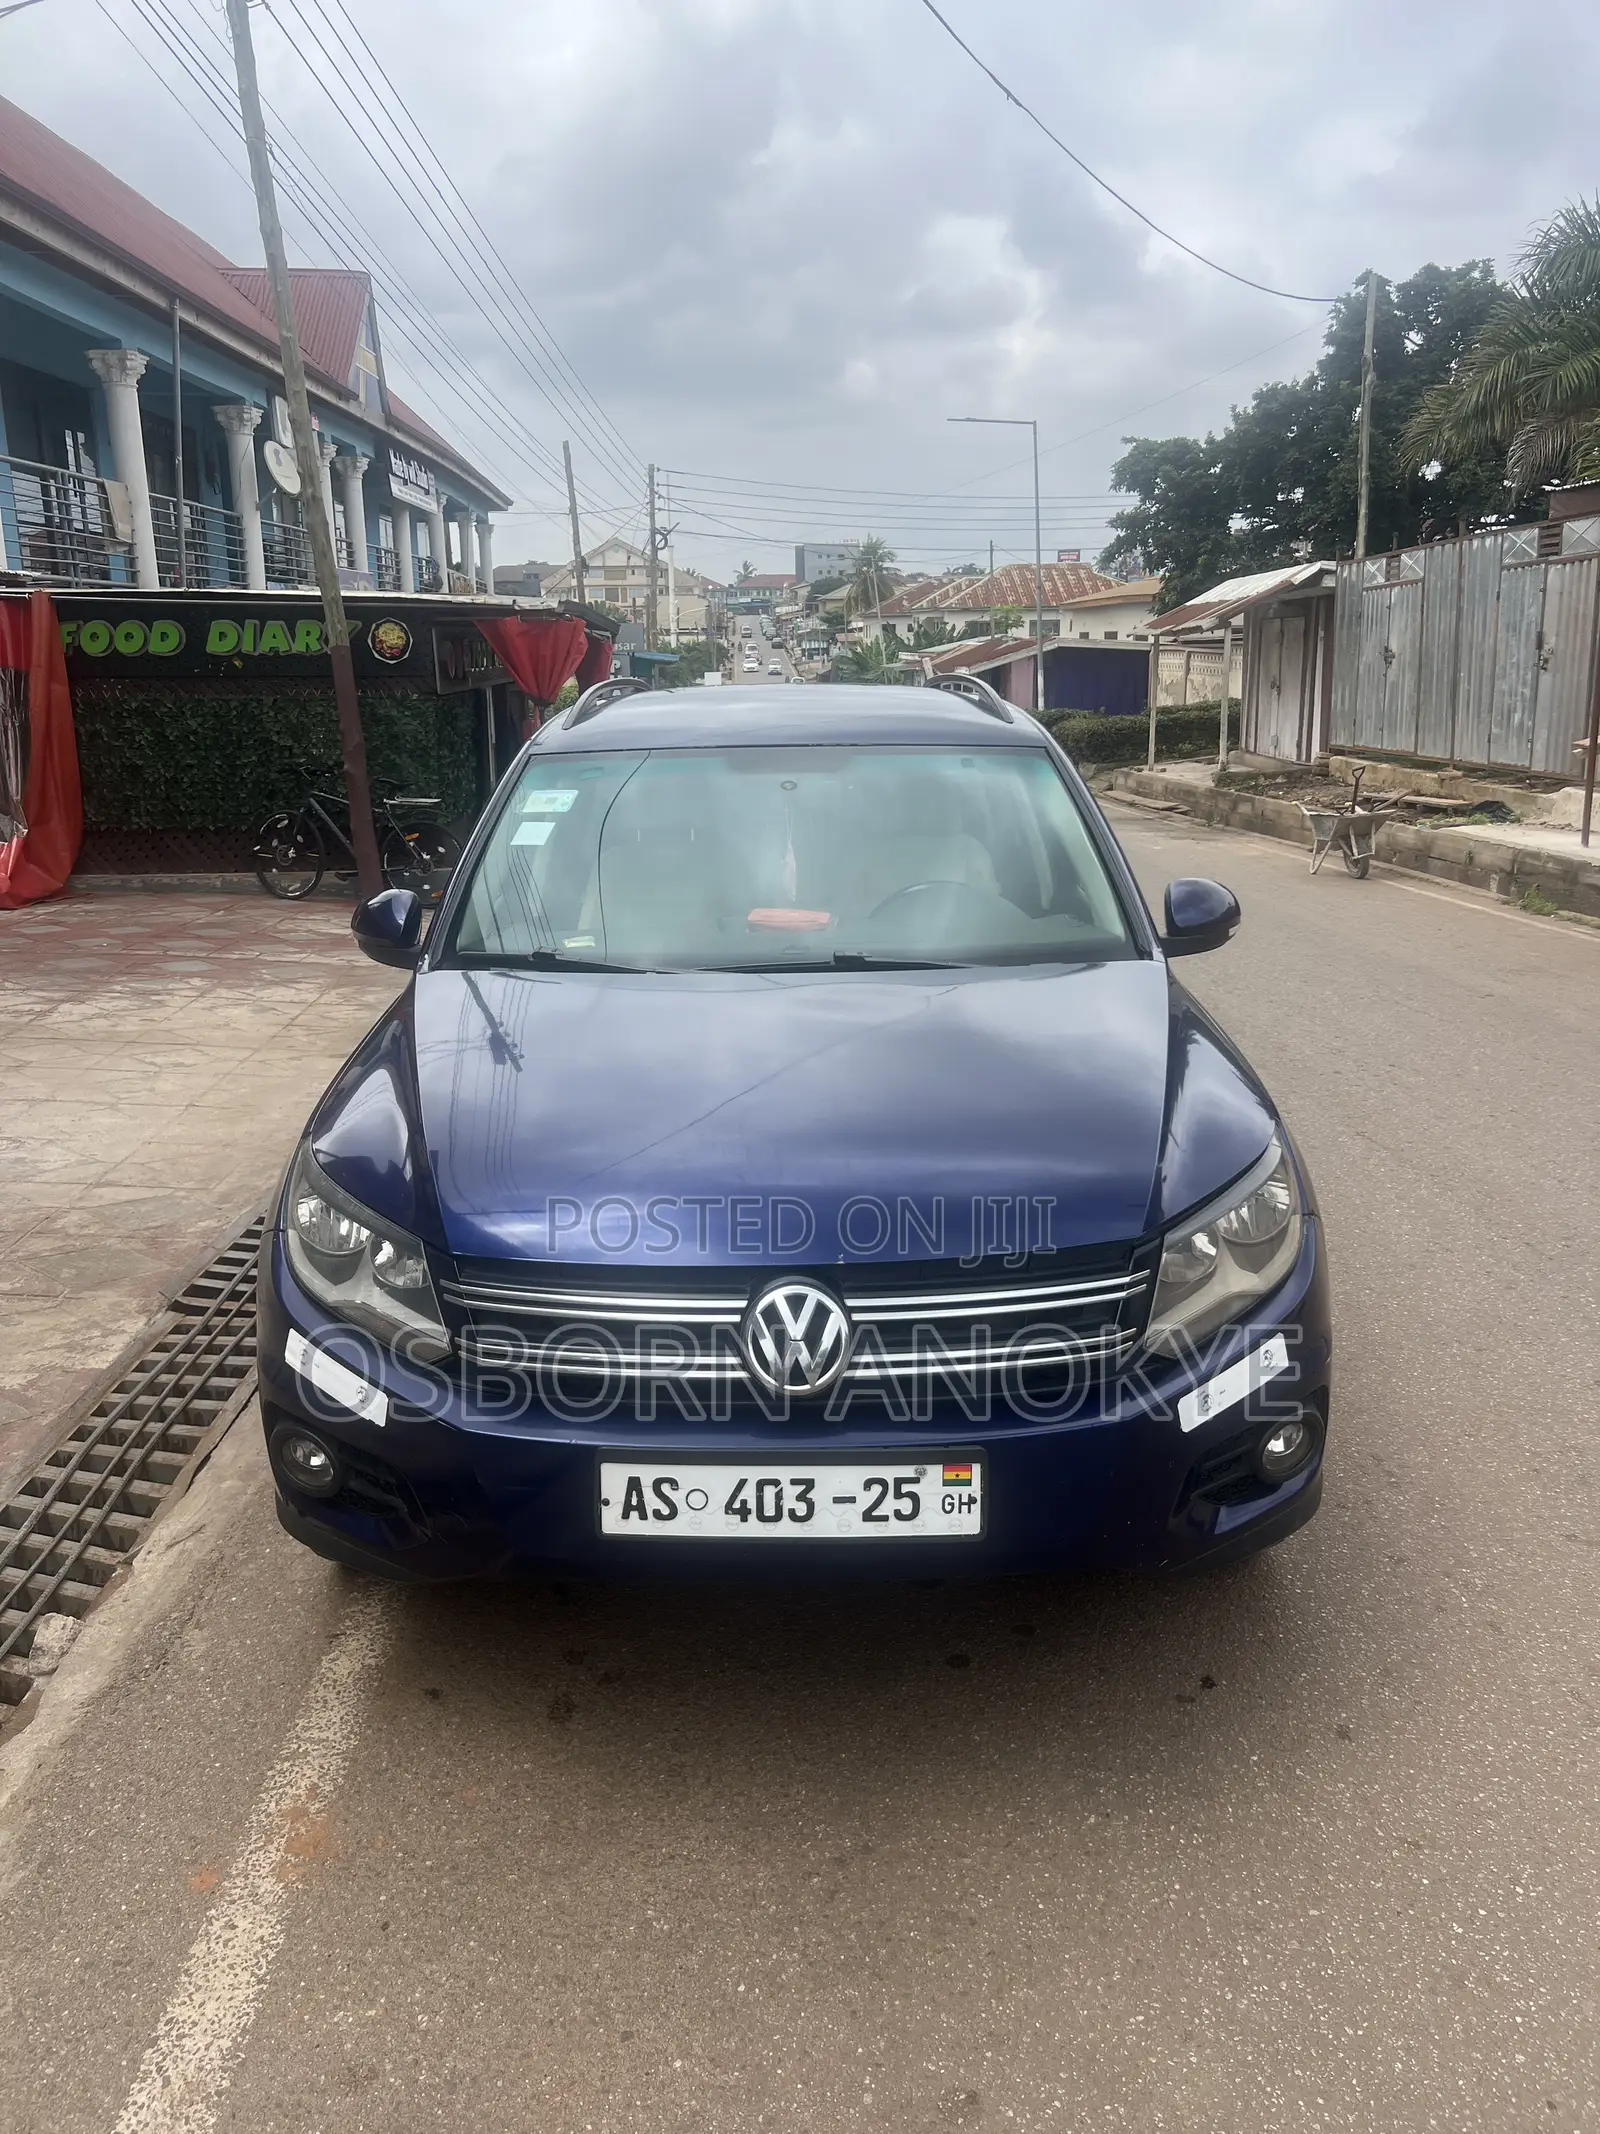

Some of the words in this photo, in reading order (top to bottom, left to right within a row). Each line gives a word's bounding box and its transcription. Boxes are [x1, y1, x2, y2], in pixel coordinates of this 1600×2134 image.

[60, 620, 186, 656] FOOD
[748, 1286, 847, 1391] VW
[621, 1475, 679, 1522] AS
[724, 1478, 815, 1522] 403
[941, 1493, 974, 1515] GH
